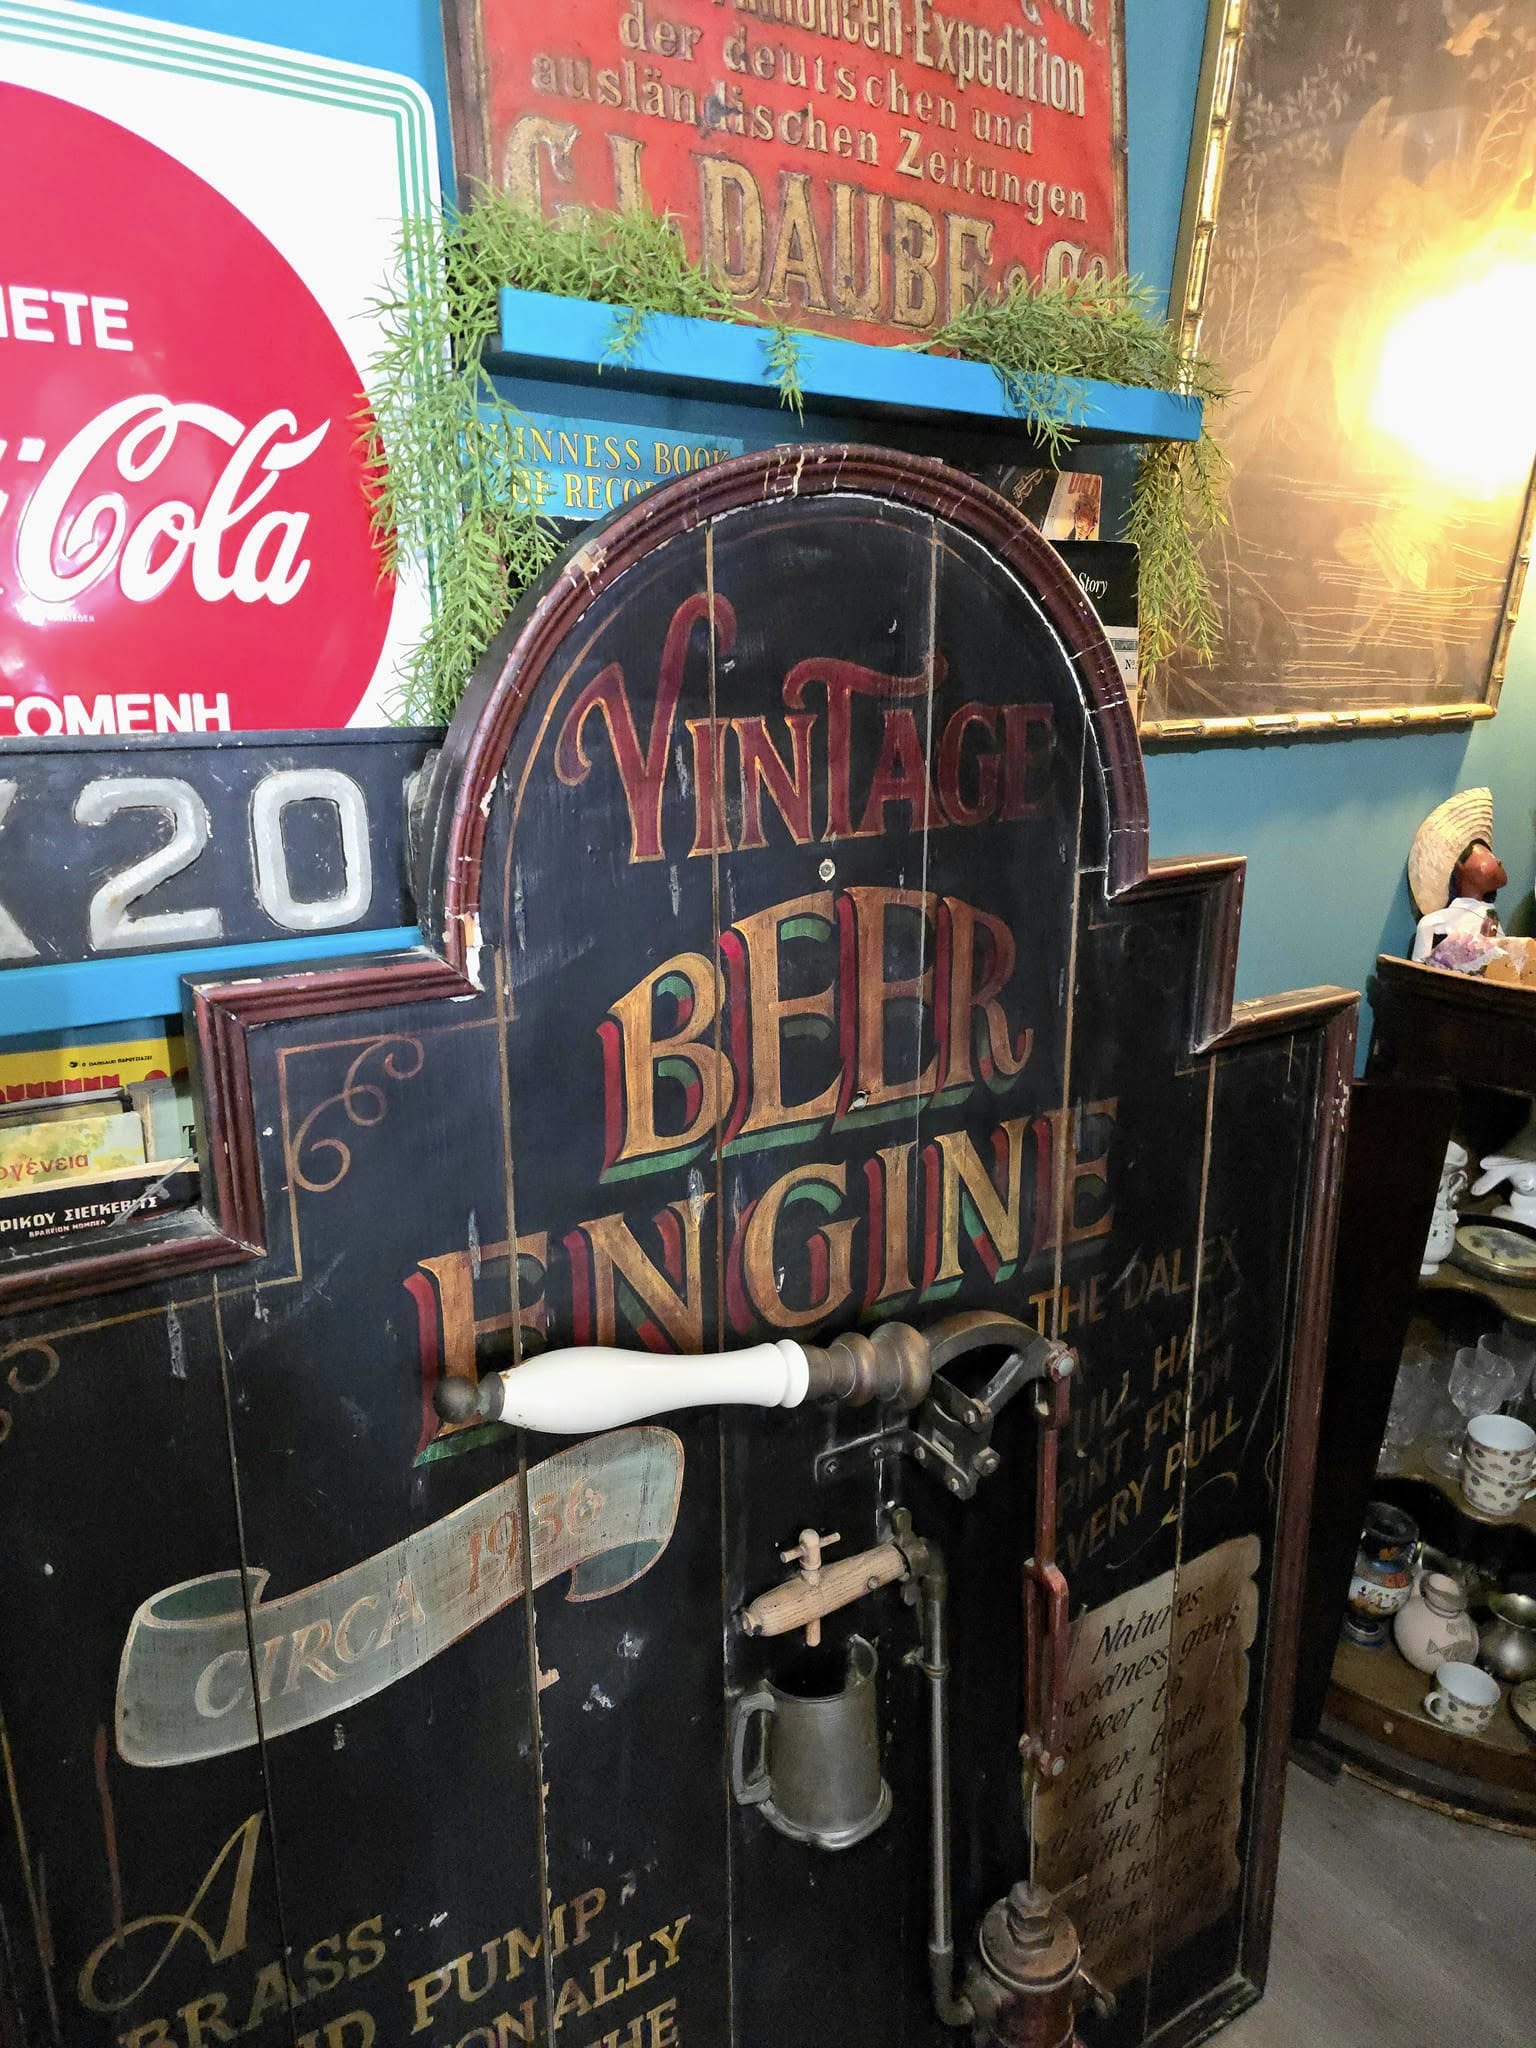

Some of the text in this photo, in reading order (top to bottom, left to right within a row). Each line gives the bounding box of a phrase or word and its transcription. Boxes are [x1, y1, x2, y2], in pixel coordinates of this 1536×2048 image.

[530, 48, 1088, 224] ausländischen Zeitungen
[617, 6, 1035, 155] der deutschen und
[0, 285, 134, 352] ΕΤΕ
[512, 469, 656, 511] OF RECO
[1078, 572, 1108, 599] Story
[0, 693, 231, 737] ΩΜΕΝΗ
[554, 591, 1056, 865] VINTAGE
[597, 886, 1035, 1168] BEER
[402, 1097, 1119, 1462] ENGINE
[1029, 1274, 1106, 1338] THE
[1064, 1396, 1243, 1570] VERY PULL
[194, 1575, 427, 1719] CIRCA
[78, 1808, 265, 2012] A
[408, 1887, 607, 2036] PUMP
